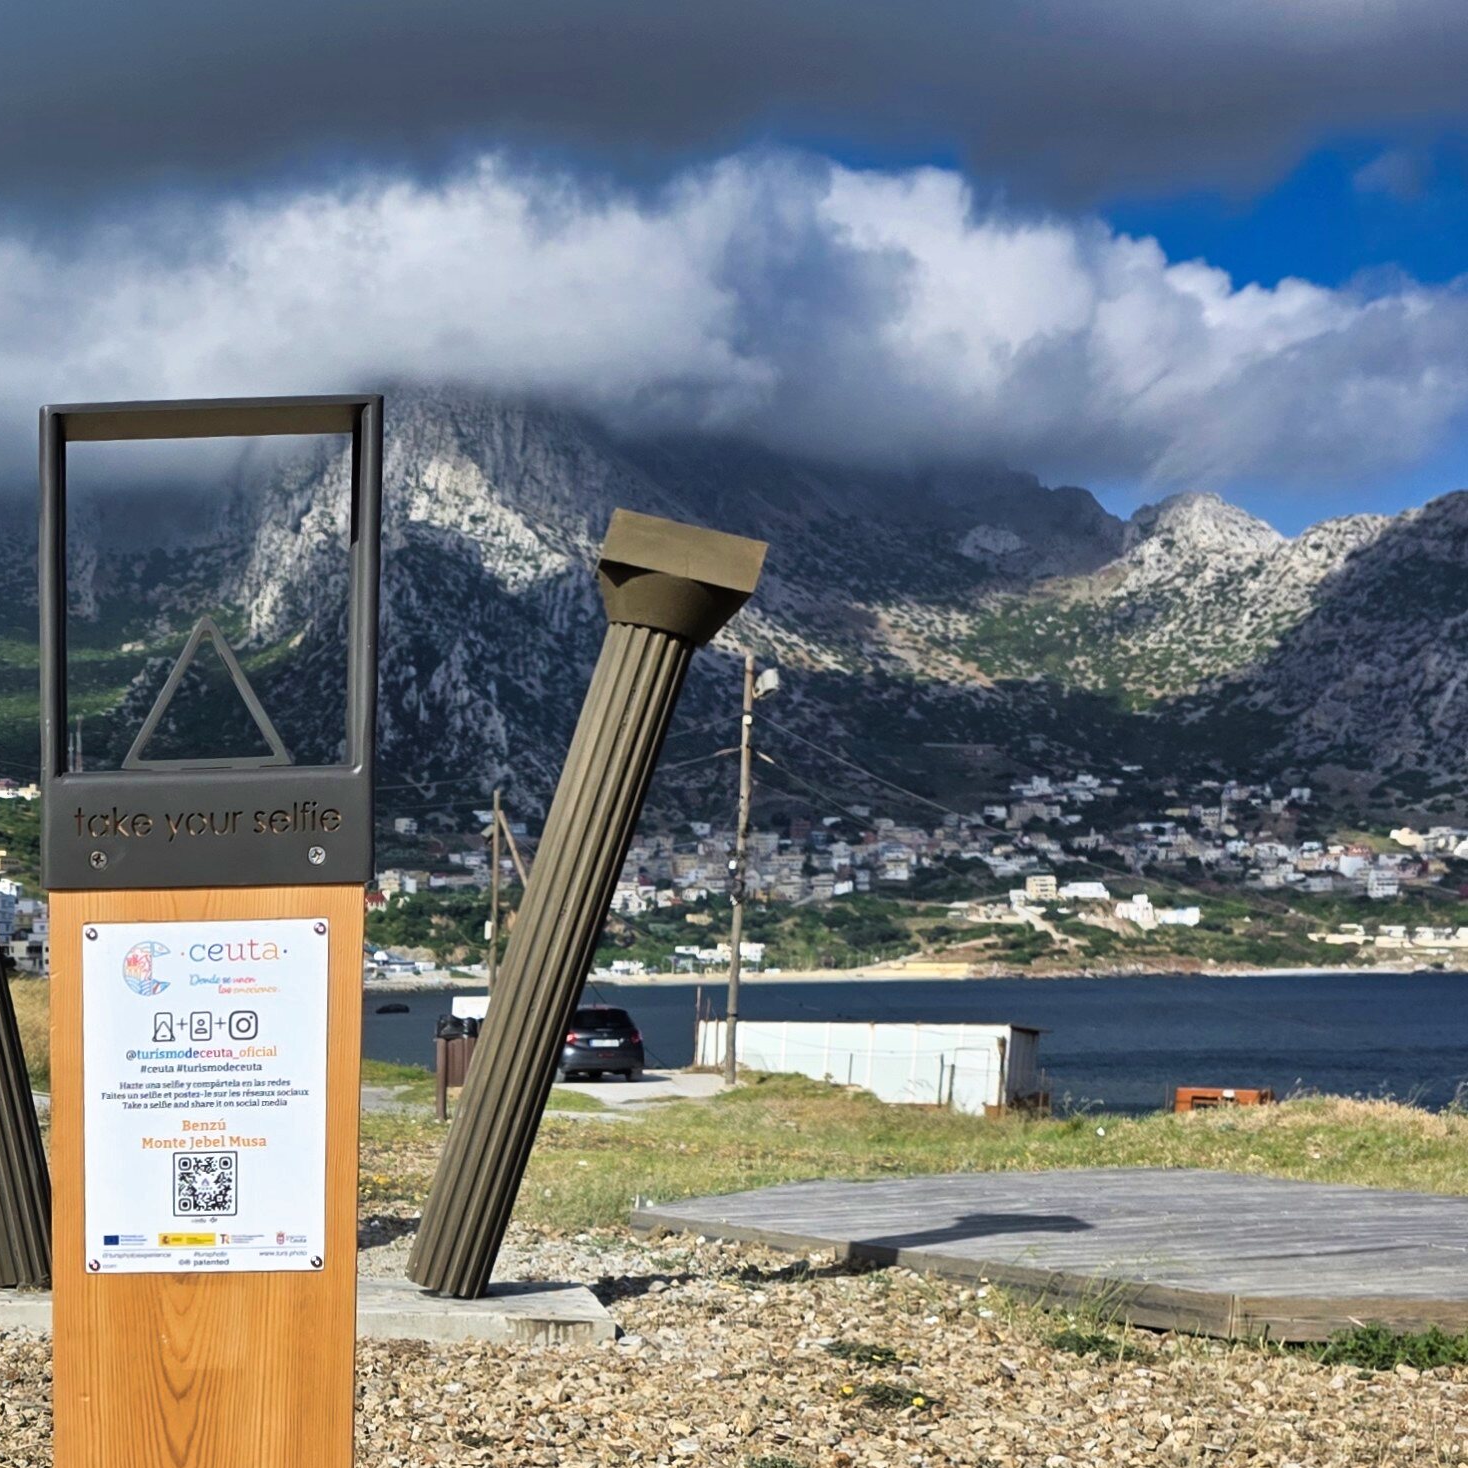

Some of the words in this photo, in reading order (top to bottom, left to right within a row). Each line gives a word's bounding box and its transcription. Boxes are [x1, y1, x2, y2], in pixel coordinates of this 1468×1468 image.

[74, 807, 153, 838] take
[165, 810, 243, 842] your
[253, 801, 341, 835] selfie
[126, 1046, 277, 1061] @turismodeceuta_oficial
[141, 1065, 175, 1073] #ceuta
[177, 1062, 262, 1073] #turismodeceuta
[162, 1080, 184, 1089] selfie
[254, 1078, 266, 1087] las
[267, 1078, 291, 1087] redes
[101, 1092, 126, 1100] Faites
[140, 1091, 162, 1099] selfie
[213, 1090, 227, 1098] sur
[229, 1090, 241, 1098] les
[276, 1088, 309, 1096] sociaux
[123, 1101, 142, 1109] Take
[150, 1100, 172, 1109] selfie
[173, 1100, 189, 1108] and
[191, 1100, 215, 1108] share
[223, 1099, 234, 1107] on
[236, 1098, 260, 1107] social
[261, 1098, 288, 1107] media
[182, 1118, 226, 1131] Benzú
[142, 1137, 187, 1149] Monte
[189, 1135, 225, 1149] Jebel
[229, 1136, 267, 1147] Musa
[193, 1258, 230, 1266] patented
